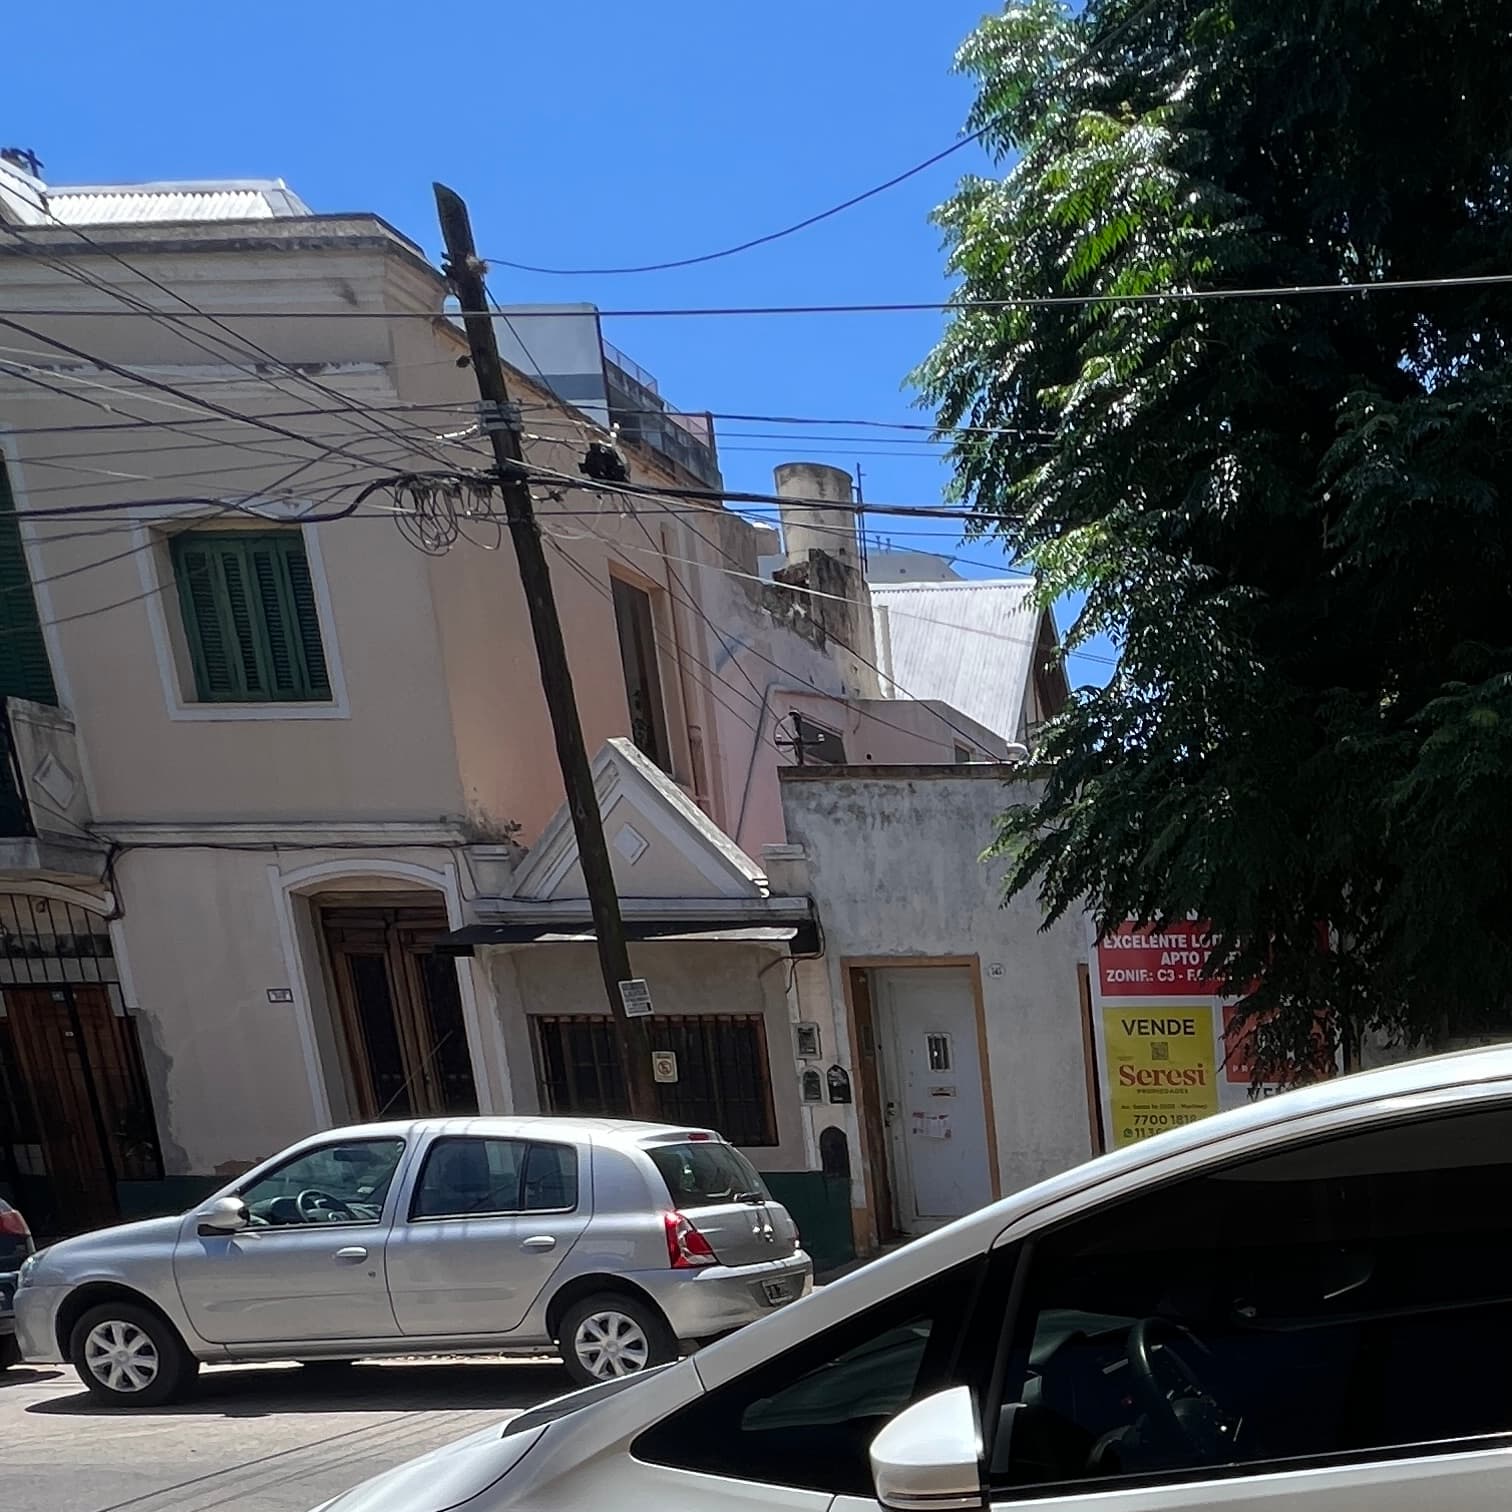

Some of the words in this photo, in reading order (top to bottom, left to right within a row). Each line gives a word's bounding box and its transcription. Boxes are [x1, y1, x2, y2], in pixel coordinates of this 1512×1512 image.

[1103, 934, 1187, 949] EXCELENTE
[1161, 952, 1199, 966] APTO
[1157, 969, 1175, 982] C3
[1121, 1019, 1196, 1036] VENDE
[1119, 1063, 1206, 1087] Seresi
[1134, 1115, 1168, 1125] 7700
